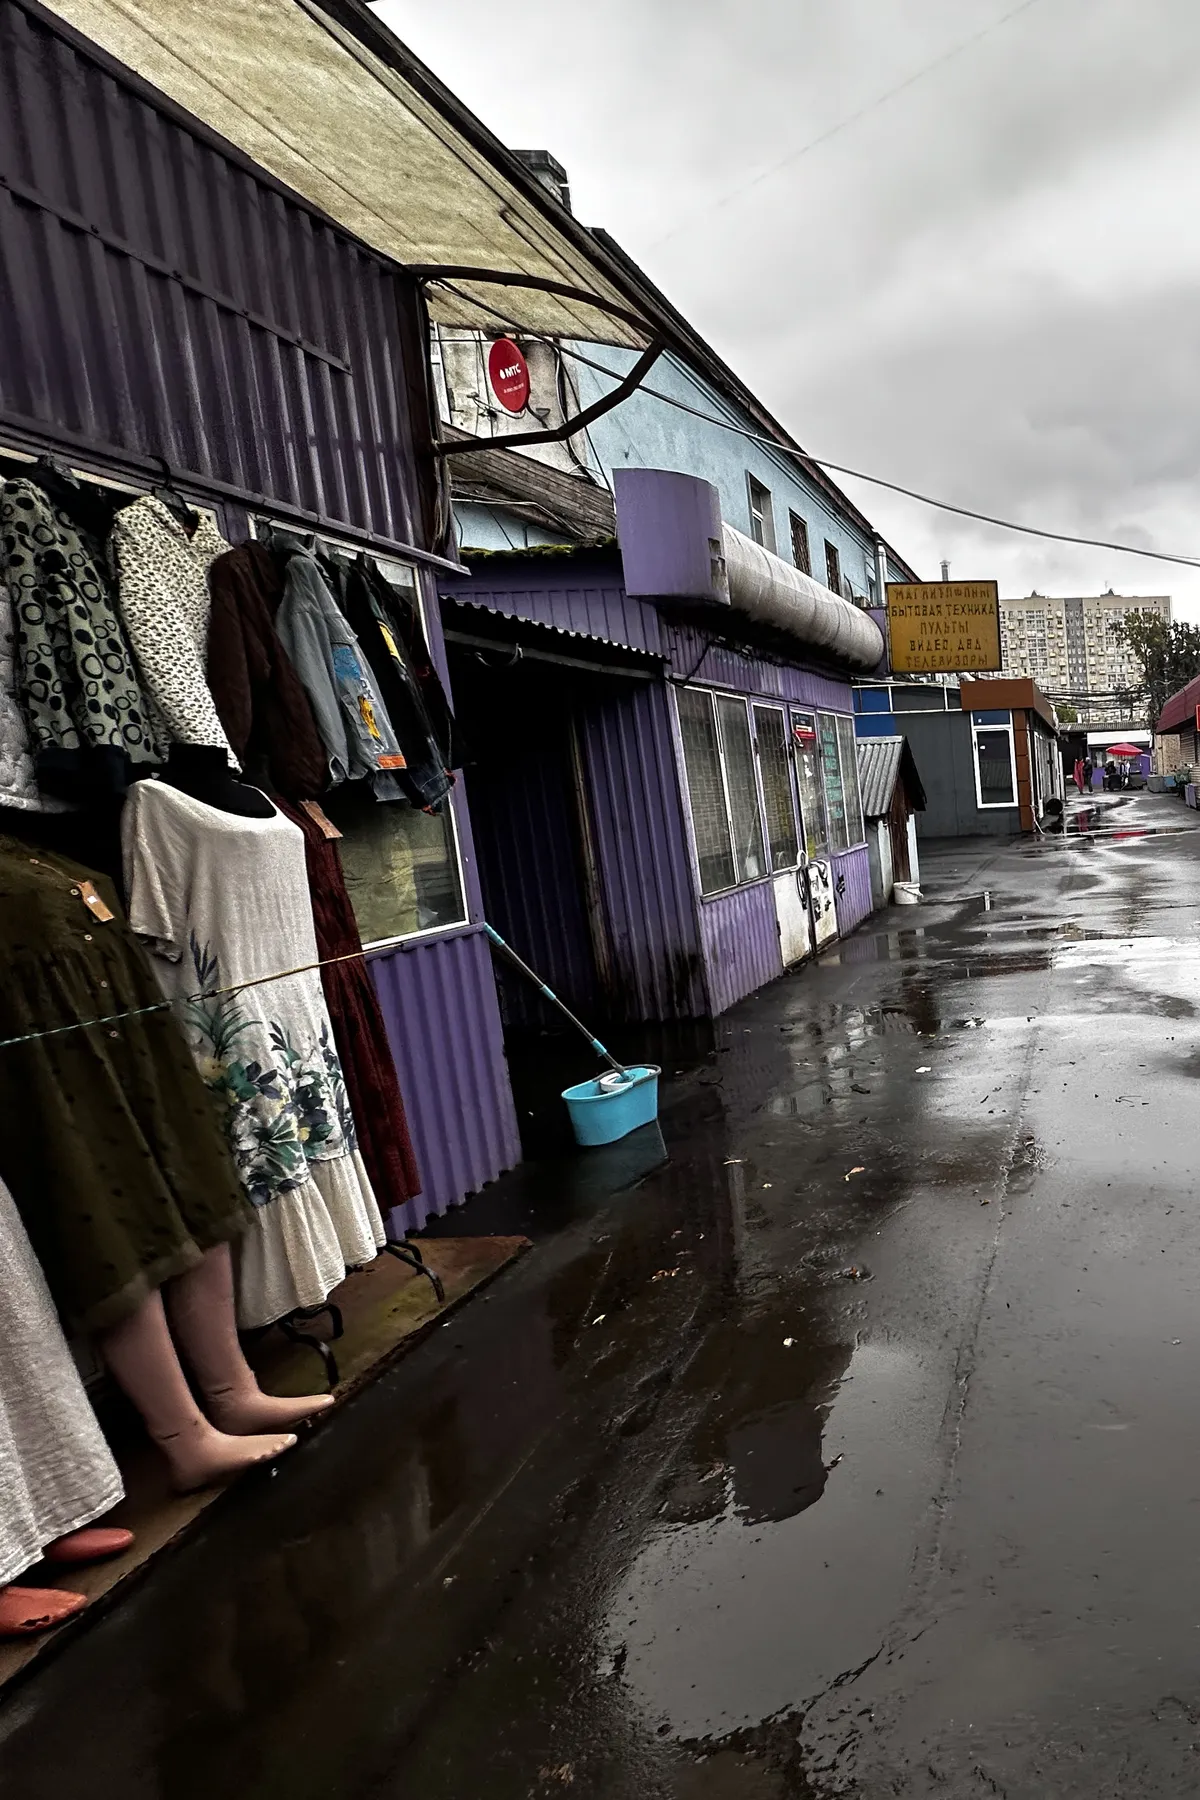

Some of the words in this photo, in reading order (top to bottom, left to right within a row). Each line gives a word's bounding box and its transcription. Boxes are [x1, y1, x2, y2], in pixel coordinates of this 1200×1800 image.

[505, 363, 521, 378] МТС
[893, 586, 990, 600] МАГНИТОФОНЫ
[891, 604, 942, 617] БЫТОВАЯ
[945, 603, 995, 616] ТЕХНИКА
[920, 621, 969, 635] ПУЛЬТЫ
[904, 653, 988, 669] ТЕЛЕВИЗОРЫ
